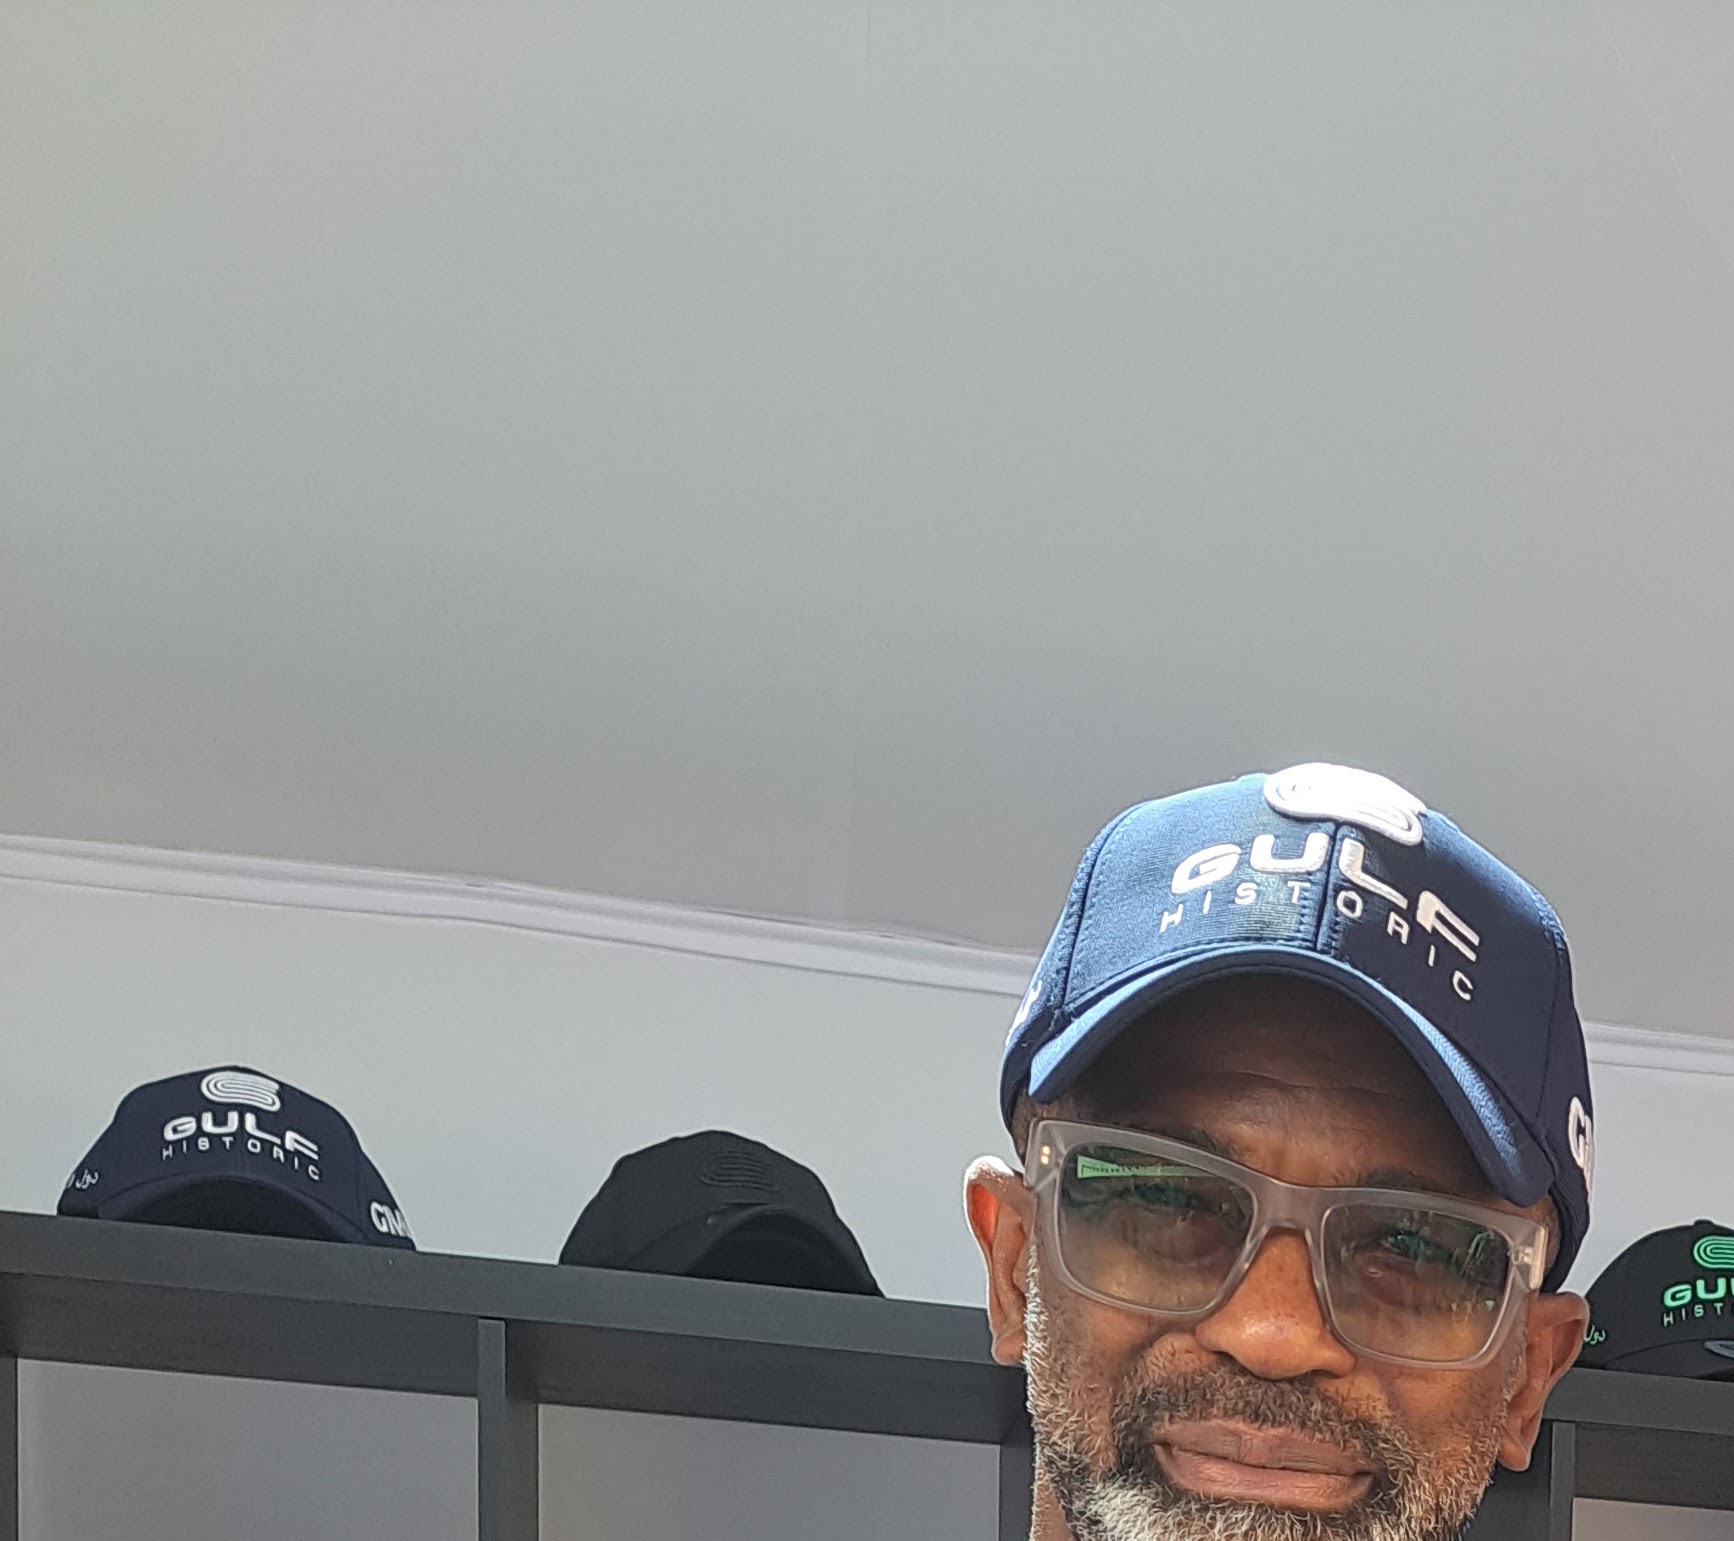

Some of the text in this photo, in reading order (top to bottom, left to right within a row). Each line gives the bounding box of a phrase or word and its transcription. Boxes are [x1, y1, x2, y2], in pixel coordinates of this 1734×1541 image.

[1171, 831, 1481, 964] GULF
[1159, 879, 1477, 1004] HISTORIC
[161, 1136, 321, 1182] HISTORIC
[163, 1110, 320, 1160] GULF
